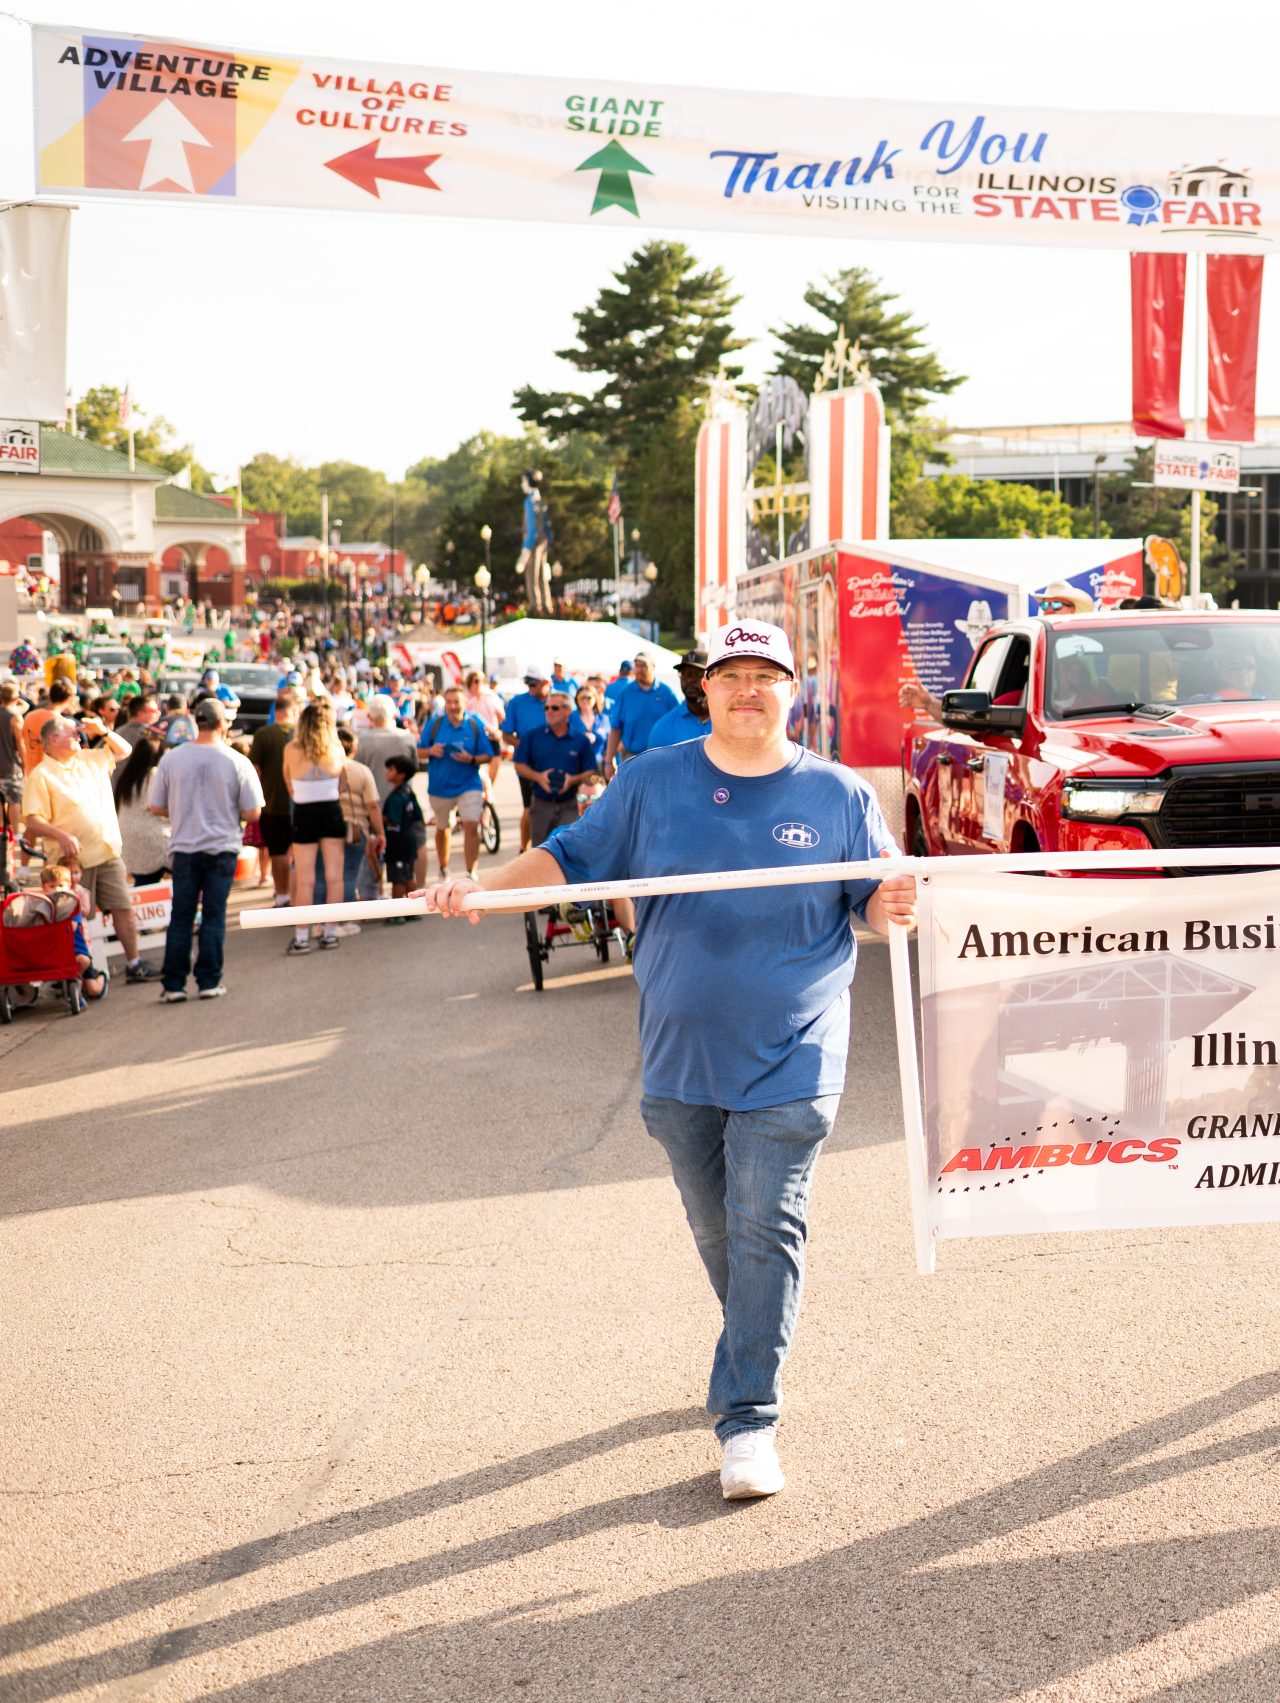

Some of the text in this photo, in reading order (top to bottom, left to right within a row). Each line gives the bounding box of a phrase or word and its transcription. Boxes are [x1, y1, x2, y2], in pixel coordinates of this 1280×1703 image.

[59, 46, 271, 82] ADVENTURE
[95, 70, 239, 99] VILLAGE
[312, 73, 453, 103] VILLAGE
[361, 97, 405, 113] OF
[564, 95, 664, 118] GIANT
[295, 109, 468, 138] CULTURES
[566, 116, 662, 138] SLIDE
[709, 115, 1049, 198] Thank You
[913, 184, 960, 199] FOR
[977, 172, 1117, 195] ILLINOIS
[801, 193, 962, 215] VISITING THE
[973, 193, 1262, 226] STATE FAIR
[0, 446, 37, 460] FAIR
[1158, 454, 1198, 464] ILLINOIS
[1156, 463, 1239, 480] STATE FAIR
[849, 601, 883, 618] Lives
[725, 628, 771, 647] Good
[957, 922, 1170, 959] American
[941, 1137, 1182, 1173] AMBUCS
